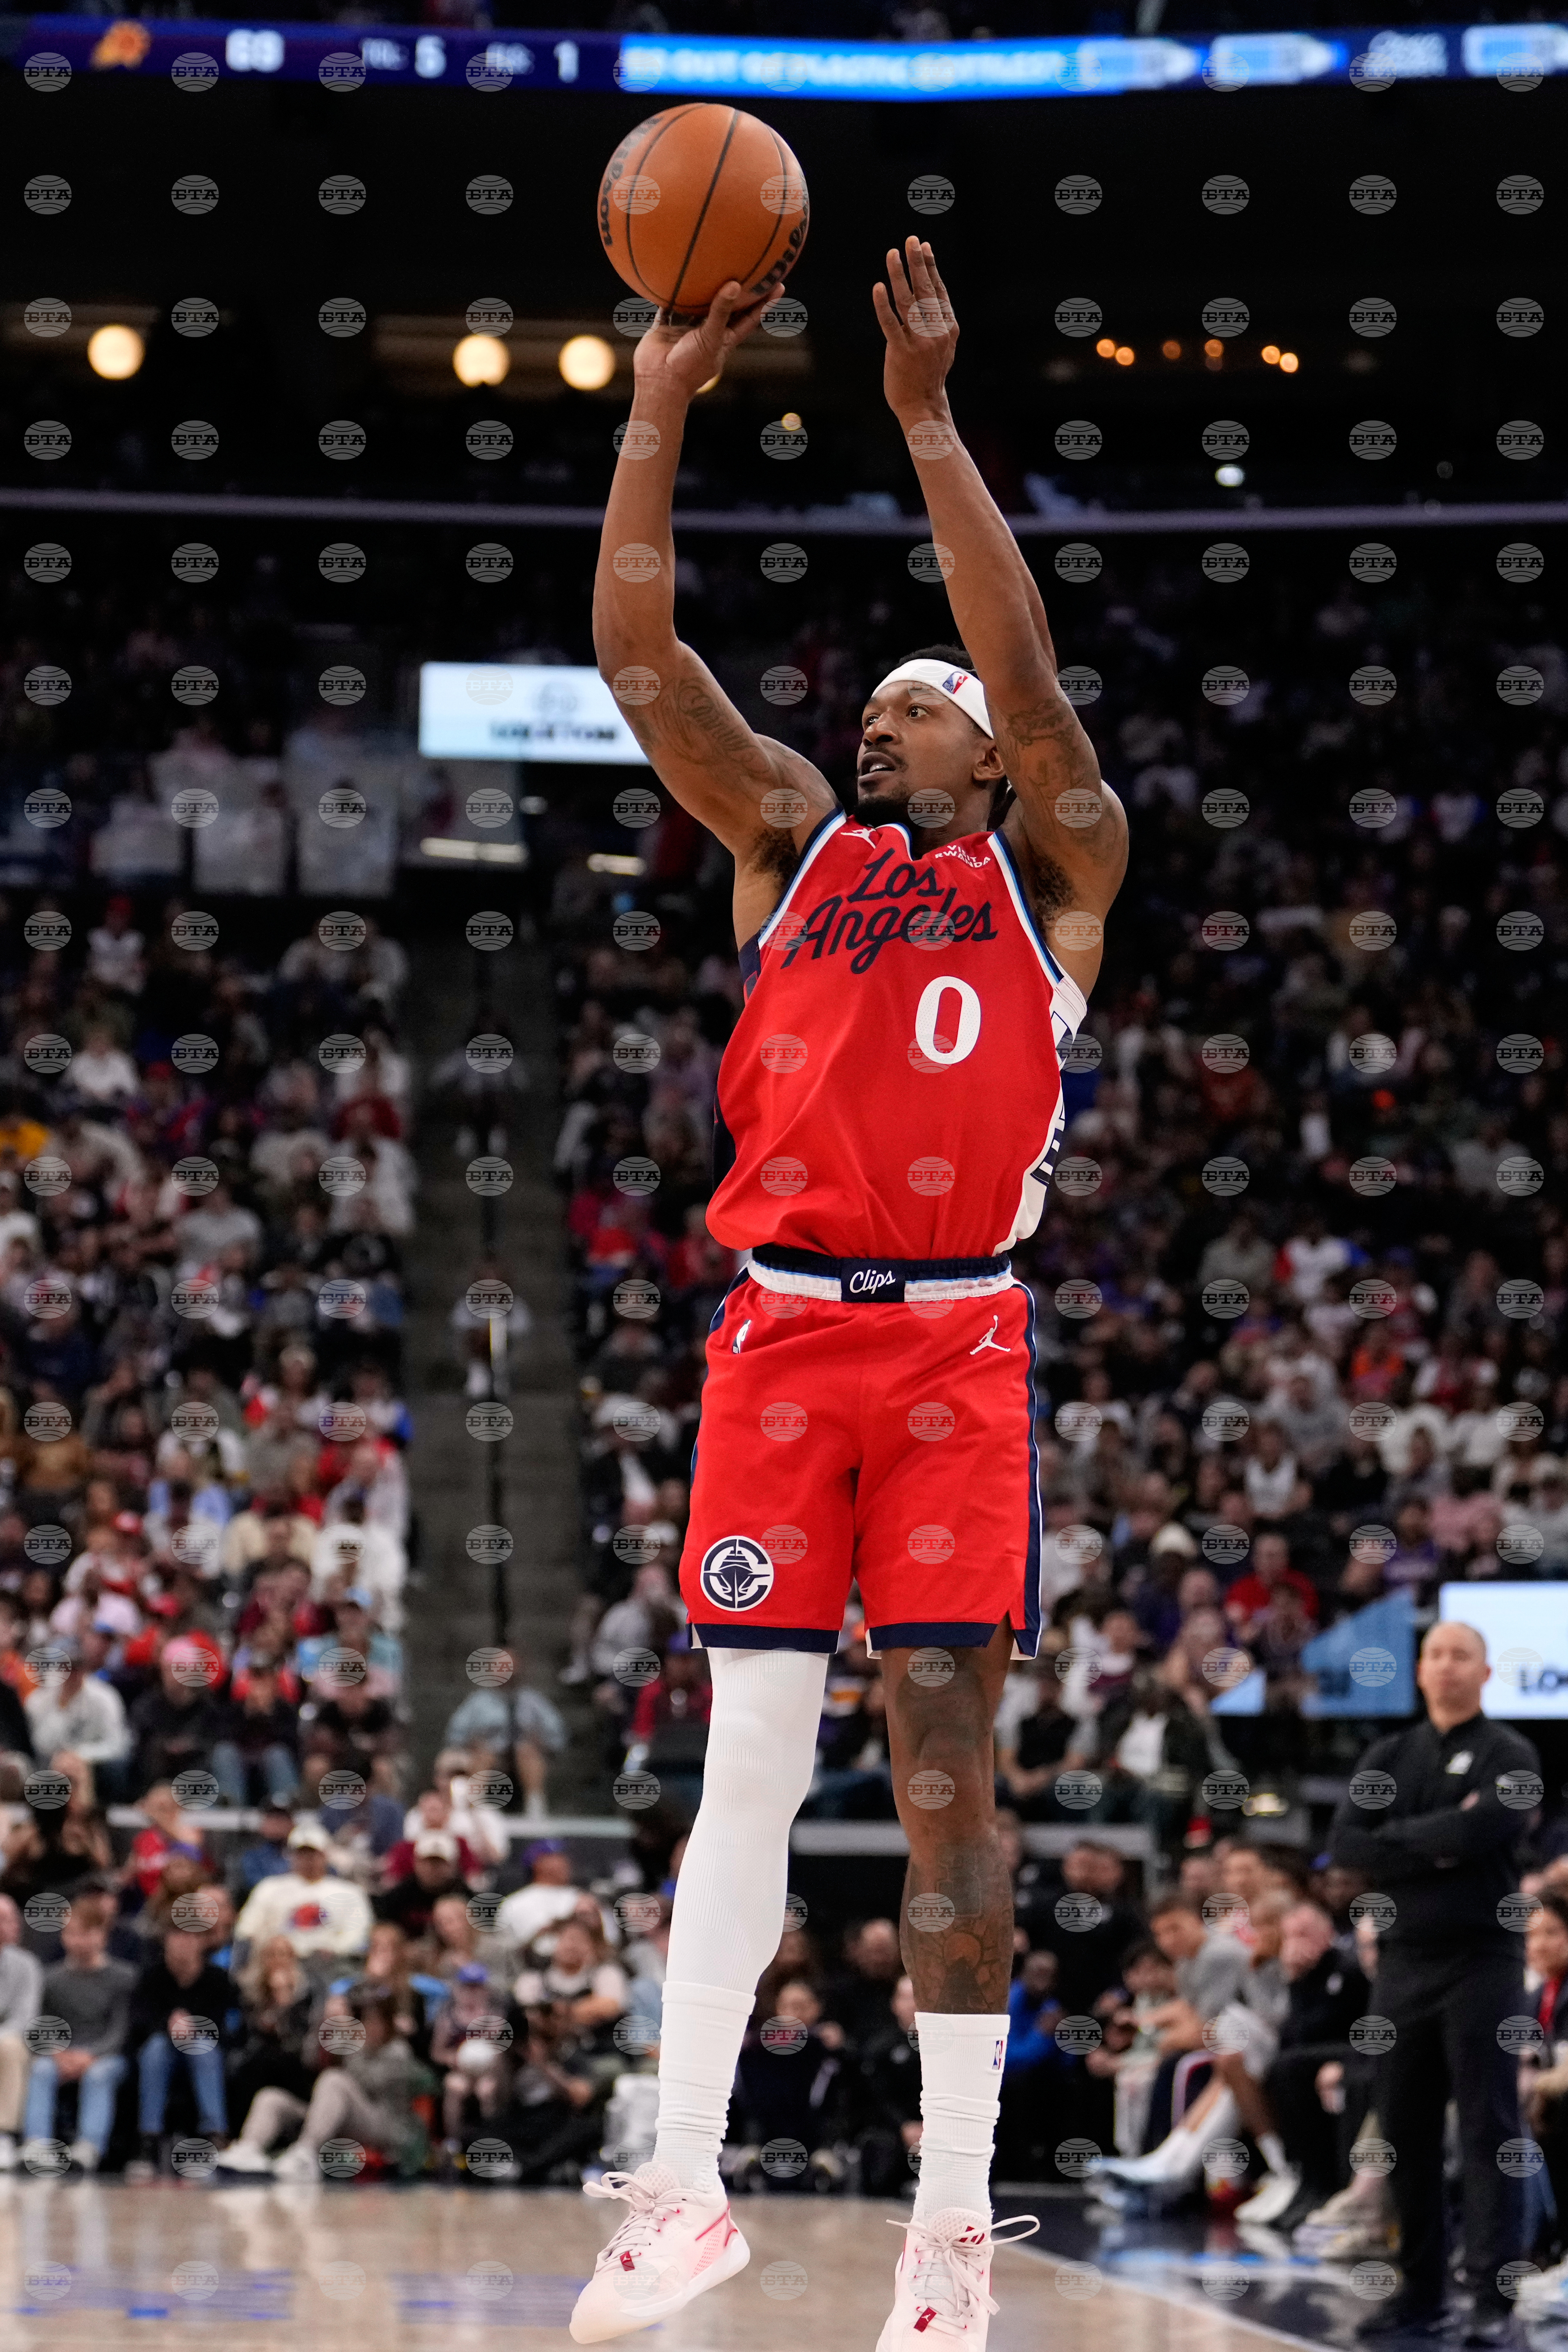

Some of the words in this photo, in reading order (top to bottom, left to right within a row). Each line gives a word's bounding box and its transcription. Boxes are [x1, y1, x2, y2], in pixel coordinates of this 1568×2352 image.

[935, 851, 991, 868] RWANDA
[947, 845, 977, 862] VISIT
[847, 847, 945, 903] Los
[780, 887, 998, 974] Angeles
[915, 976, 981, 1064] 0
[849, 1269, 896, 1294] Clips
